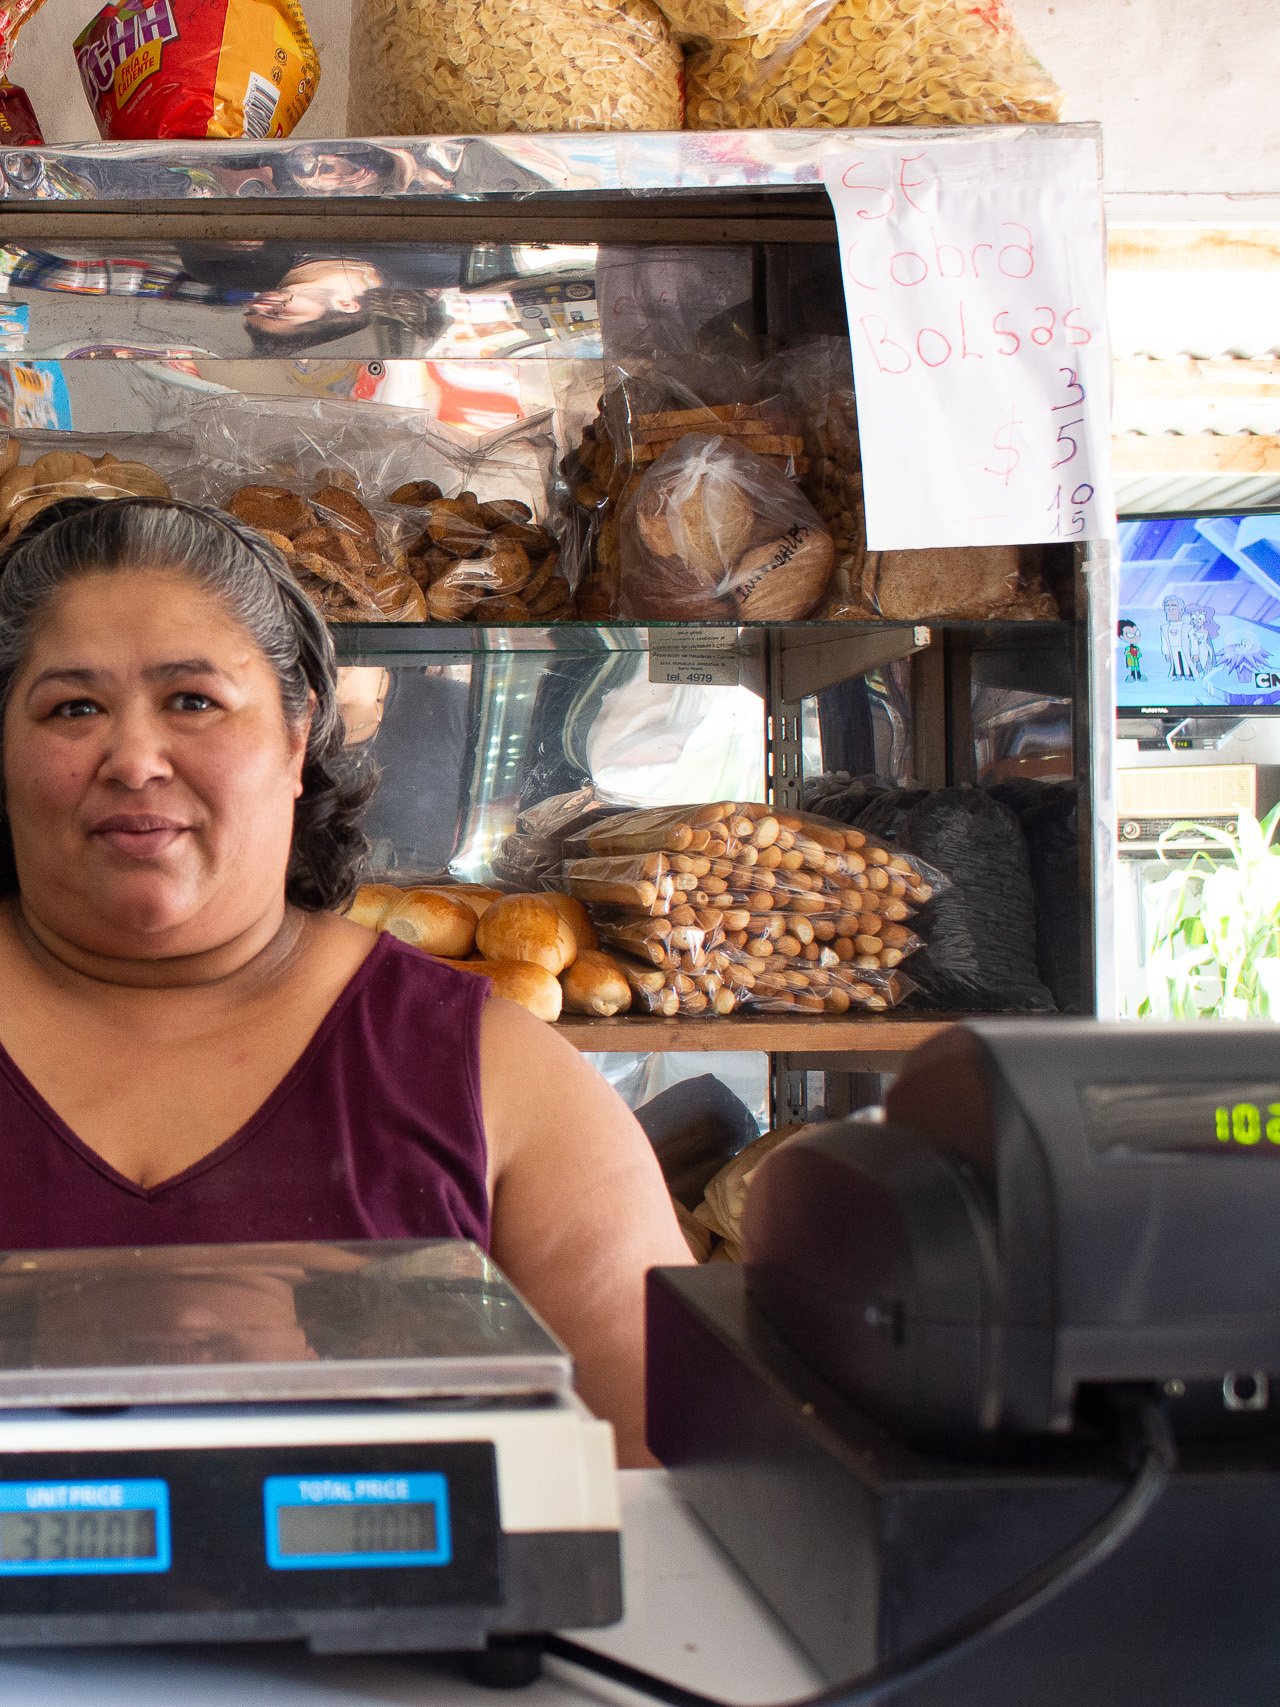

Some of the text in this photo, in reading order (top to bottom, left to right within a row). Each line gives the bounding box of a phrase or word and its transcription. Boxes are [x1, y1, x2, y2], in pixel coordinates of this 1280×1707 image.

[117, 56, 155, 98] CALIENTE
[1050, 366, 1087, 412] 3
[1051, 417, 1085, 470] 5
[1047, 482, 1095, 512] 10
[1049, 511, 1087, 538] 15
[686, 673, 713, 682] 4979
[26, 1484, 124, 1509] UNIT PRICE
[354, 1478, 410, 1501] PRICE
